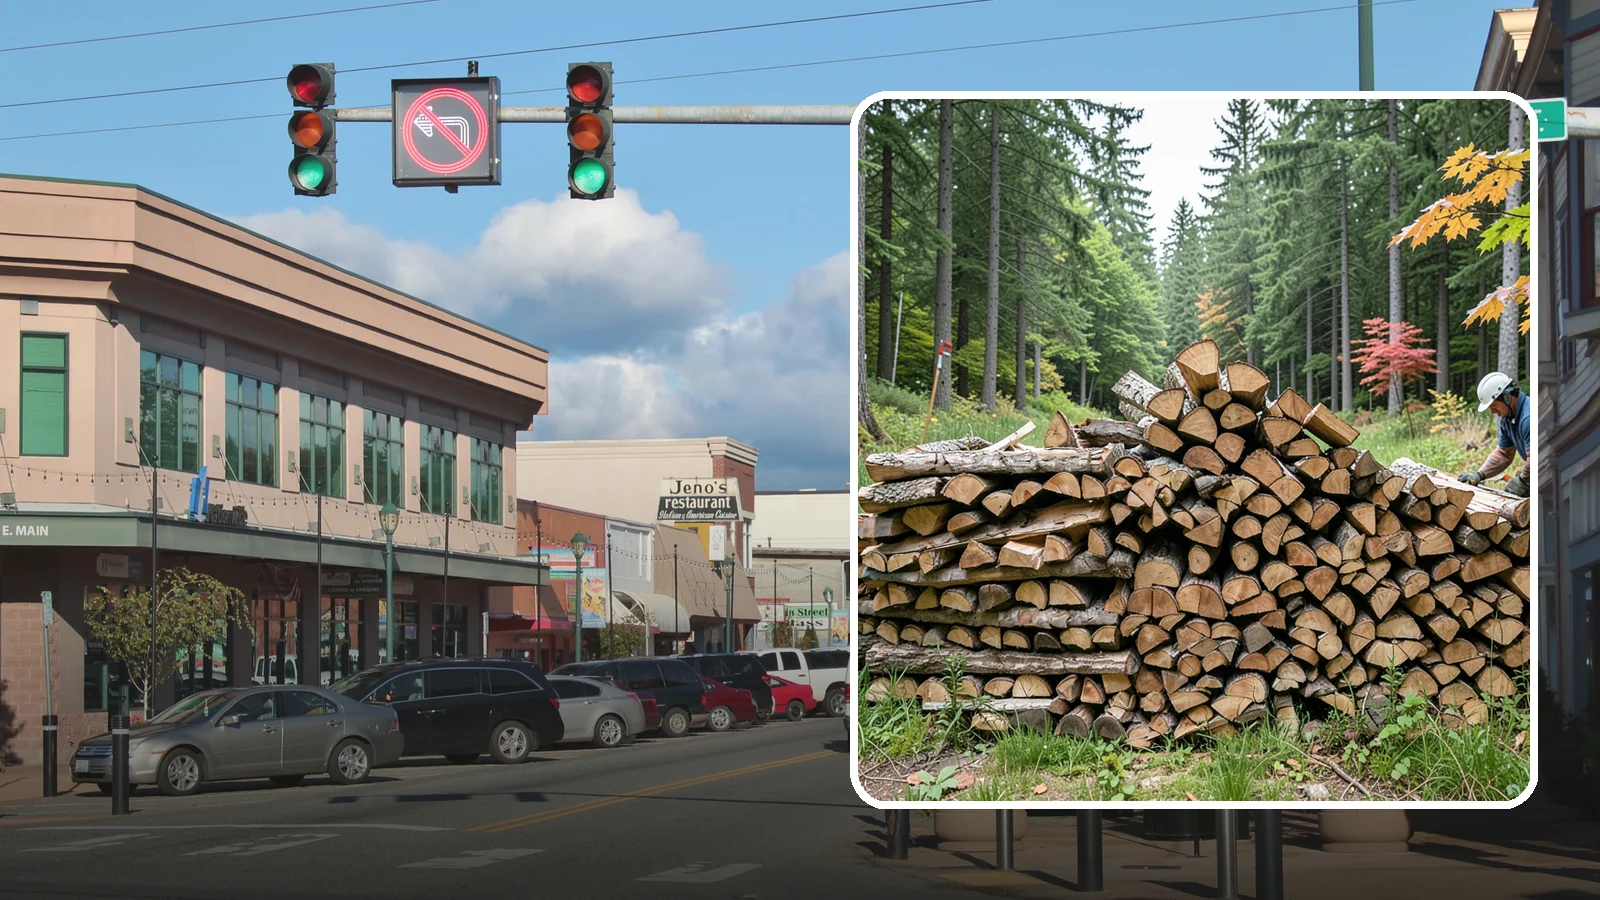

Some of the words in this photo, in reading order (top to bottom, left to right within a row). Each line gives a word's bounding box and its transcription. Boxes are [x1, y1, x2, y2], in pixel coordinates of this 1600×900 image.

[670, 480, 727, 494] Jeno's
[665, 497, 730, 509] restaurant
[659, 510, 682, 520] Italian
[686, 509, 714, 520] American
[715, 509, 737, 520] Cuisine
[2, 525, 13, 536] E.
[15, 525, 49, 536] MAIN
[797, 607, 828, 617] Street
[791, 619, 824, 627] lass
